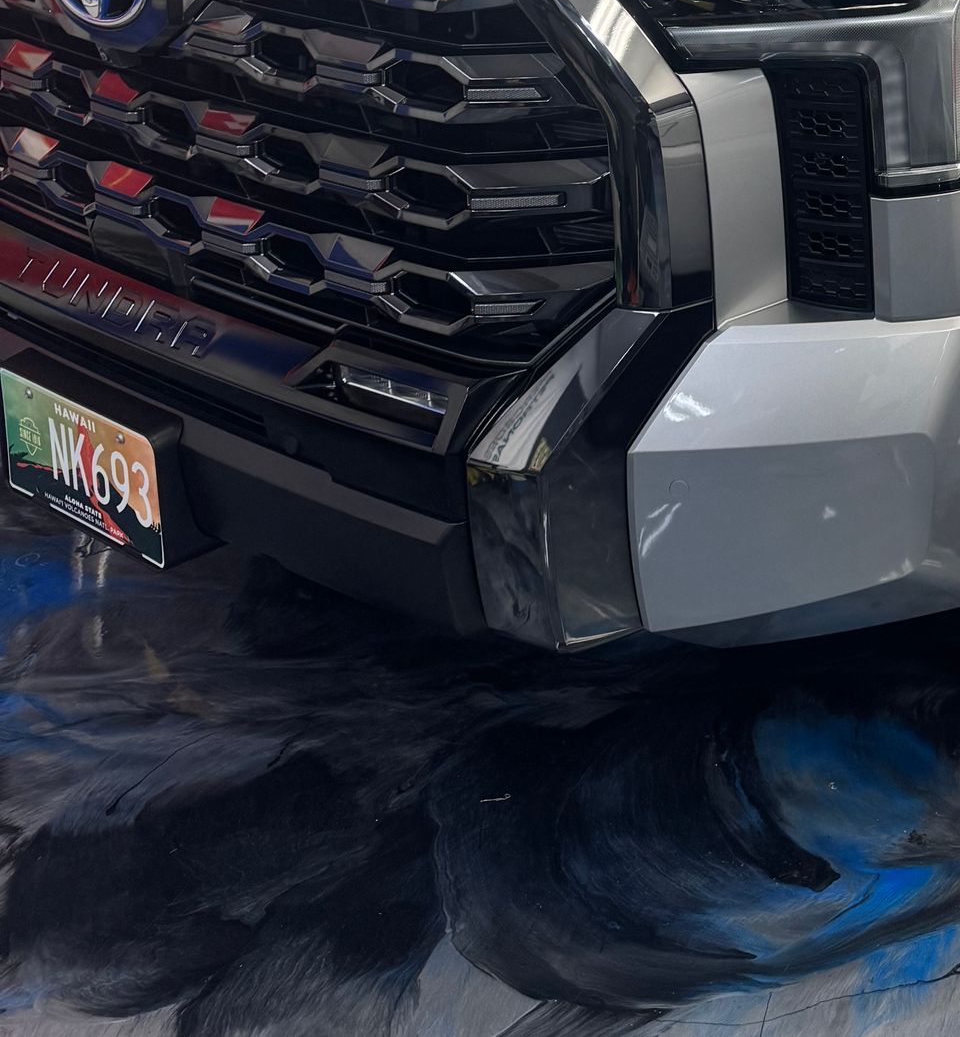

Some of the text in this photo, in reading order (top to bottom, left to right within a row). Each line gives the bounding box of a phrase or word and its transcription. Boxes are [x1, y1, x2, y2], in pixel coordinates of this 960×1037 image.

[17, 248, 217, 358] TUNDRA
[54, 403, 96, 433] HAWAII
[48, 417, 151, 528] NK693
[64, 494, 84, 509] ALOHA
